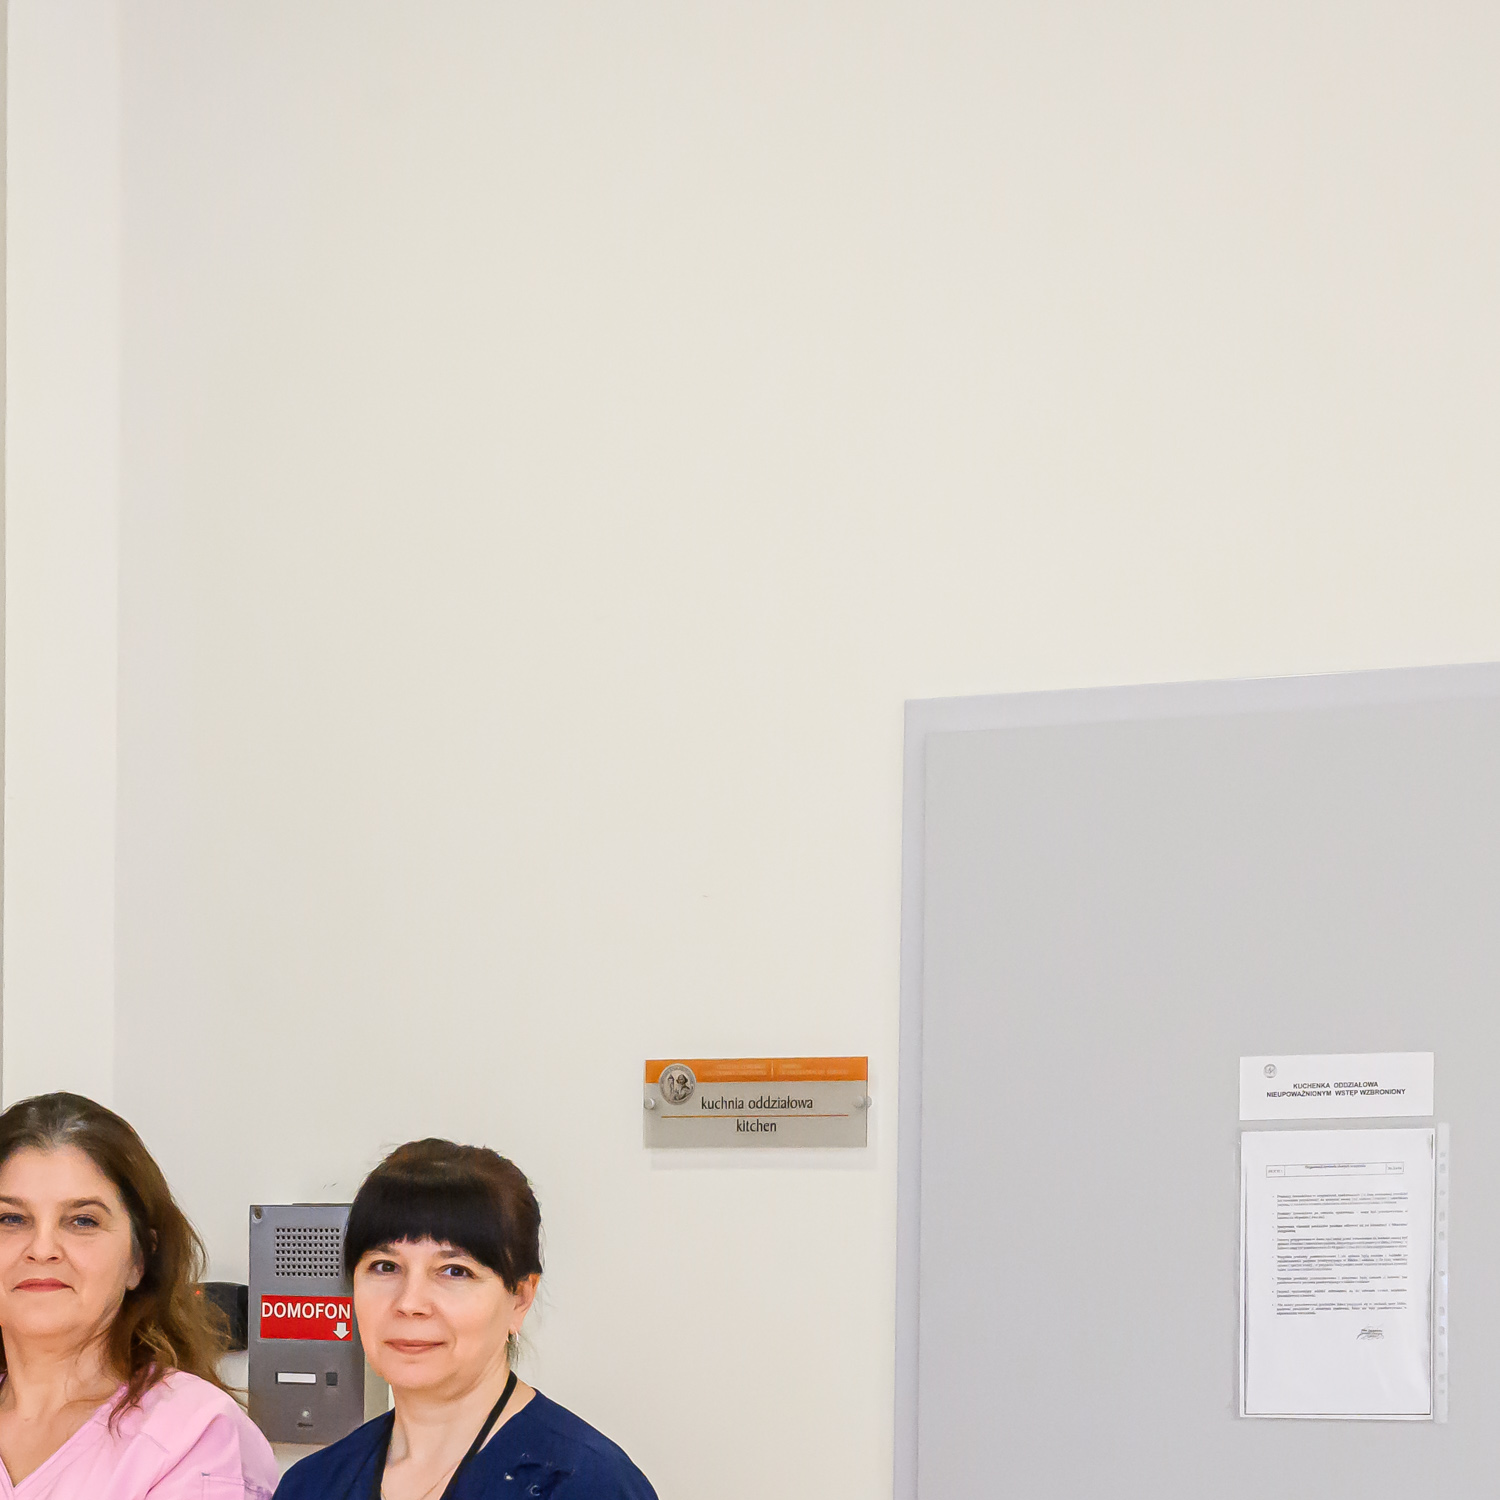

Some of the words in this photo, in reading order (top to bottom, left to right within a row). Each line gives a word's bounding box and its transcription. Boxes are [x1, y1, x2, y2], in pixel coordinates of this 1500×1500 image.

[701, 1096, 744, 1110] kuchnia
[748, 1096, 813, 1110] oddziałowa
[736, 1119, 777, 1132] kitchen
[262, 1302, 350, 1319] DOMOFON
